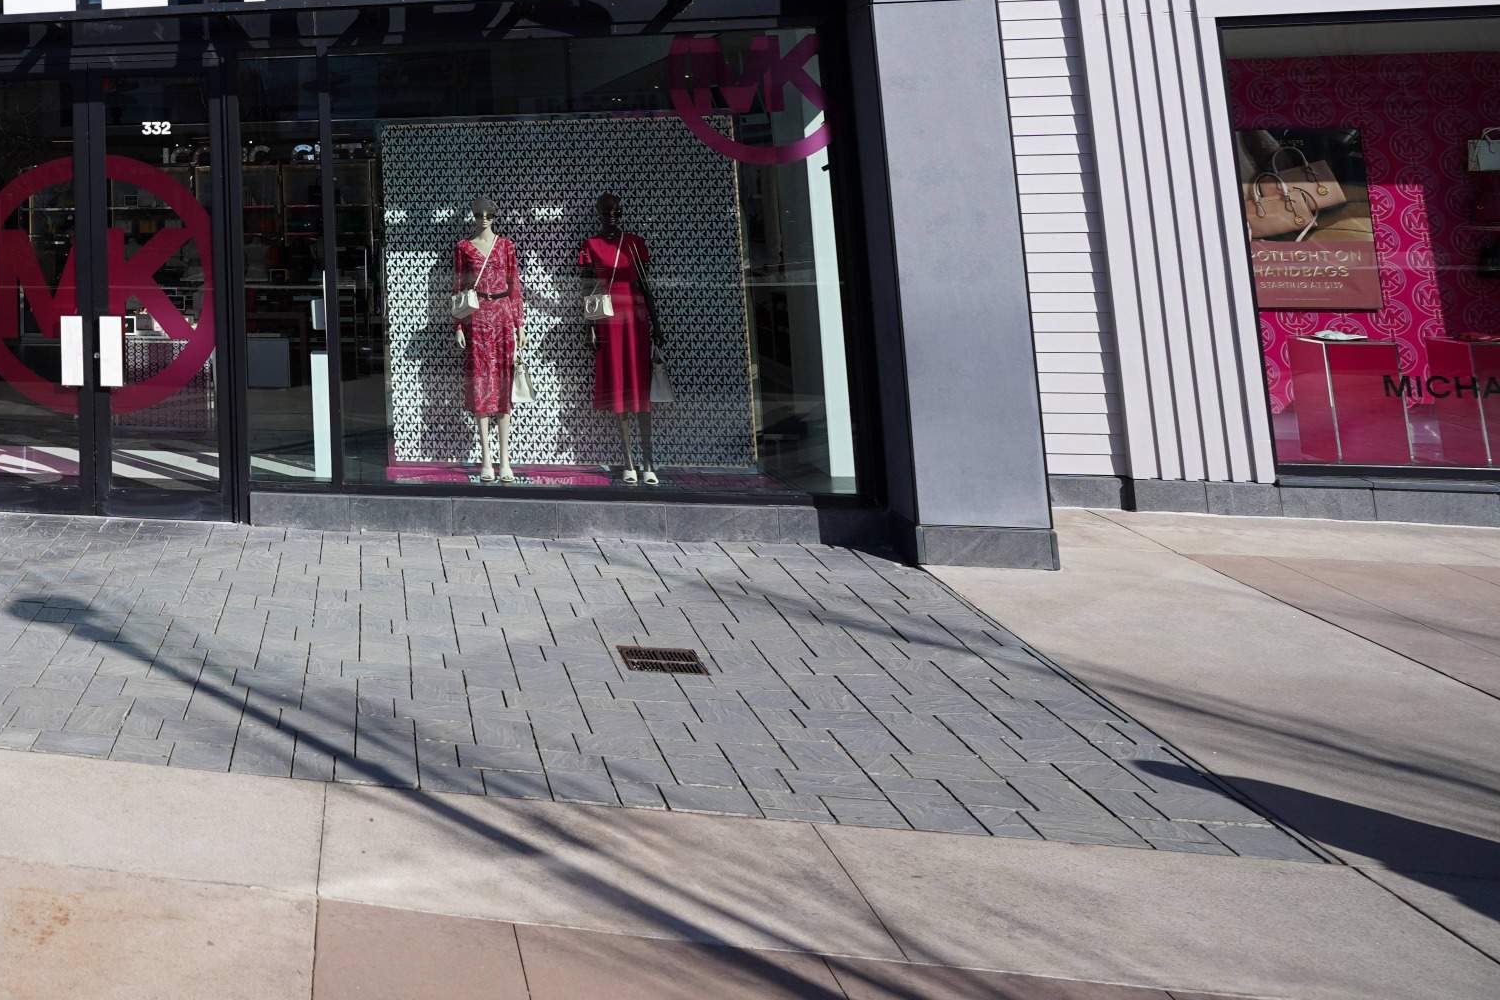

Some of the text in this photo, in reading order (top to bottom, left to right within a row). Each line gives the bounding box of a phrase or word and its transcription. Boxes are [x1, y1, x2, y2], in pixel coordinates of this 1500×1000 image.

[141, 121, 172, 136] 332
[1335, 250, 1363, 262] ON
[1382, 375, 1500, 398] MICHA
